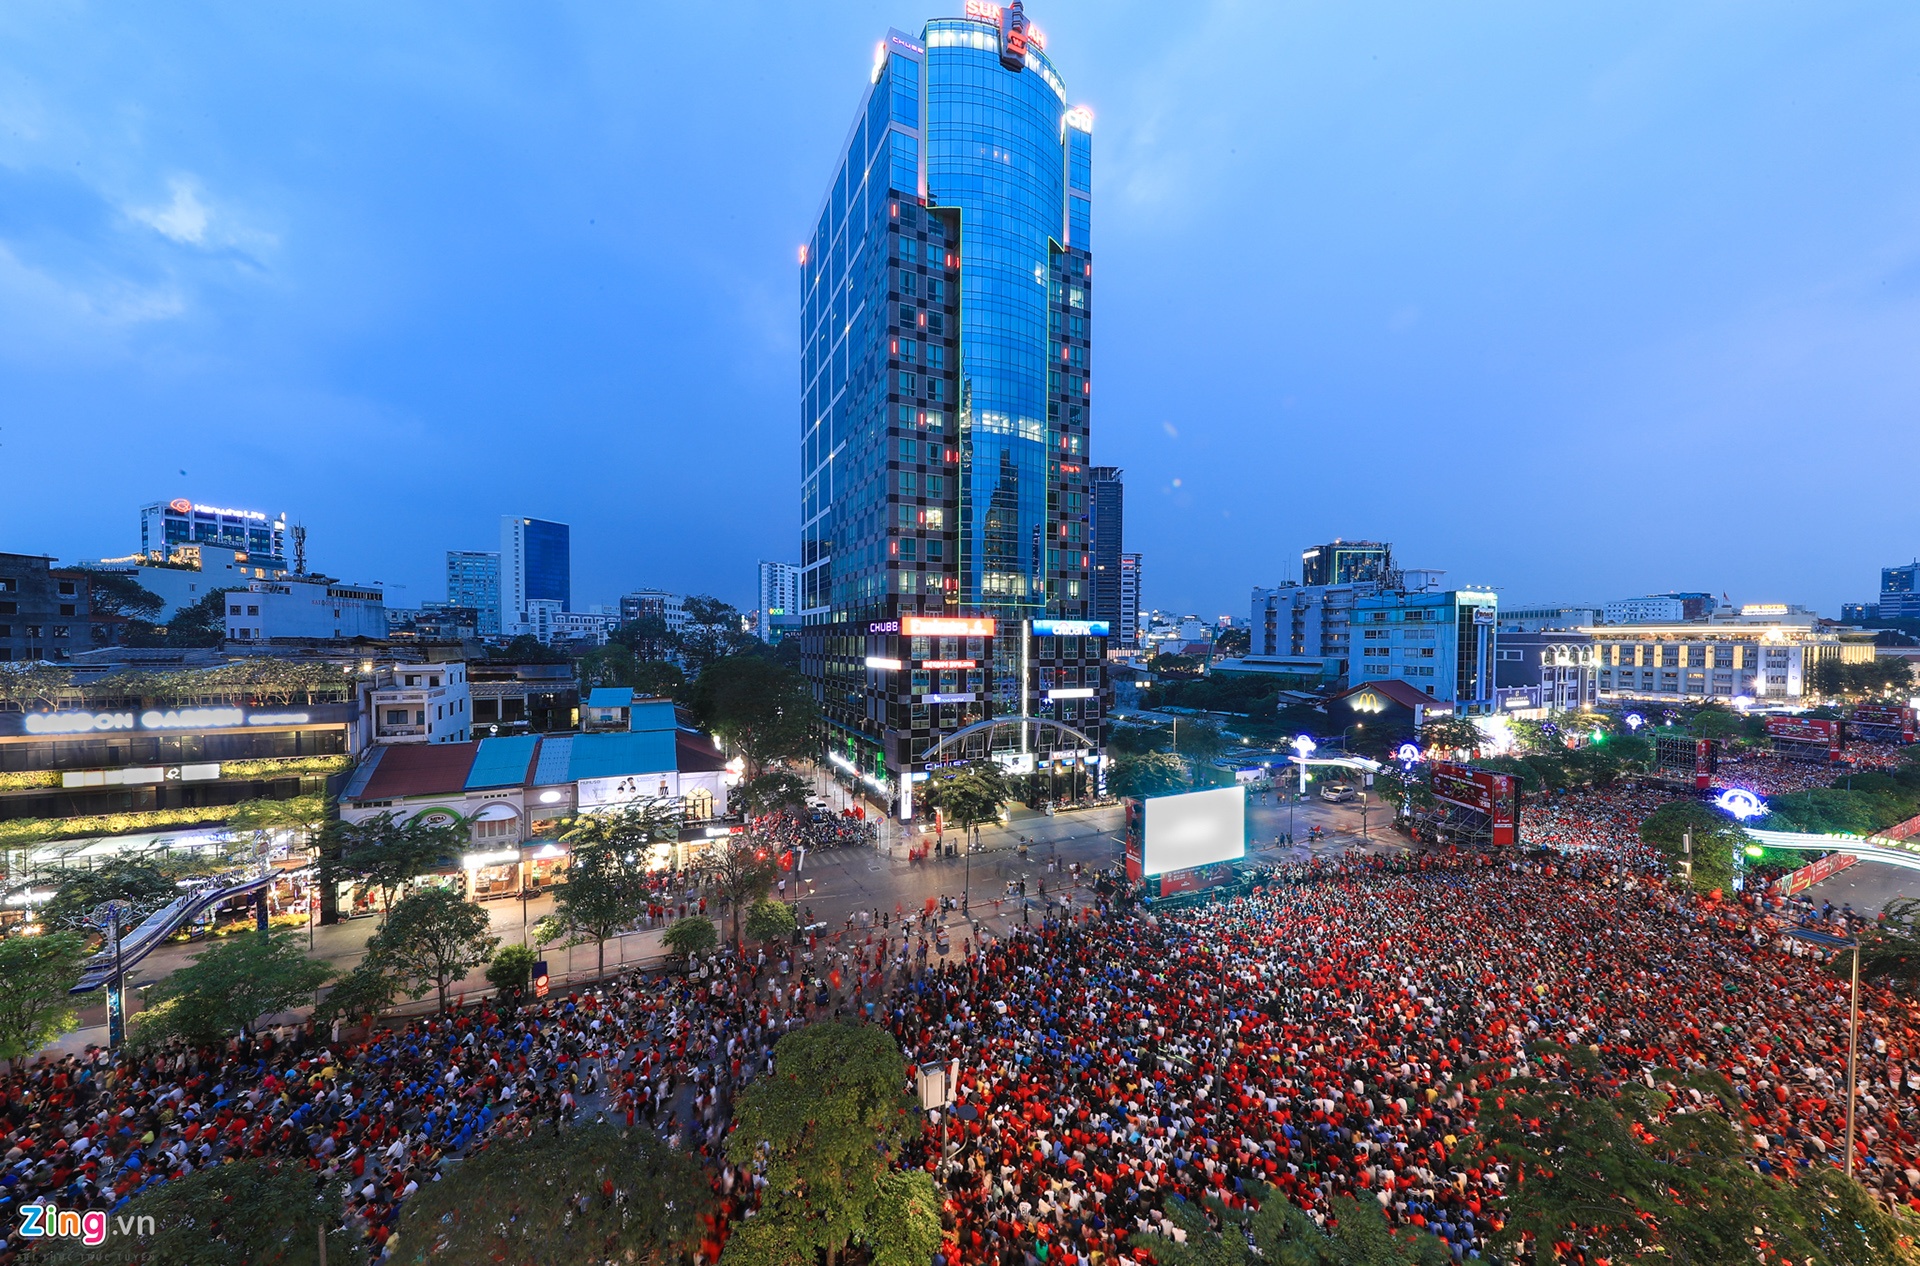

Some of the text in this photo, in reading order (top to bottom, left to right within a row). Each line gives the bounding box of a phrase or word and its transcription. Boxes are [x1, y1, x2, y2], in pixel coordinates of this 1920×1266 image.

[892, 36, 925, 54] CHUBB
[870, 622, 898, 632] CHUBB
[1871, 837, 1901, 847] NEW
